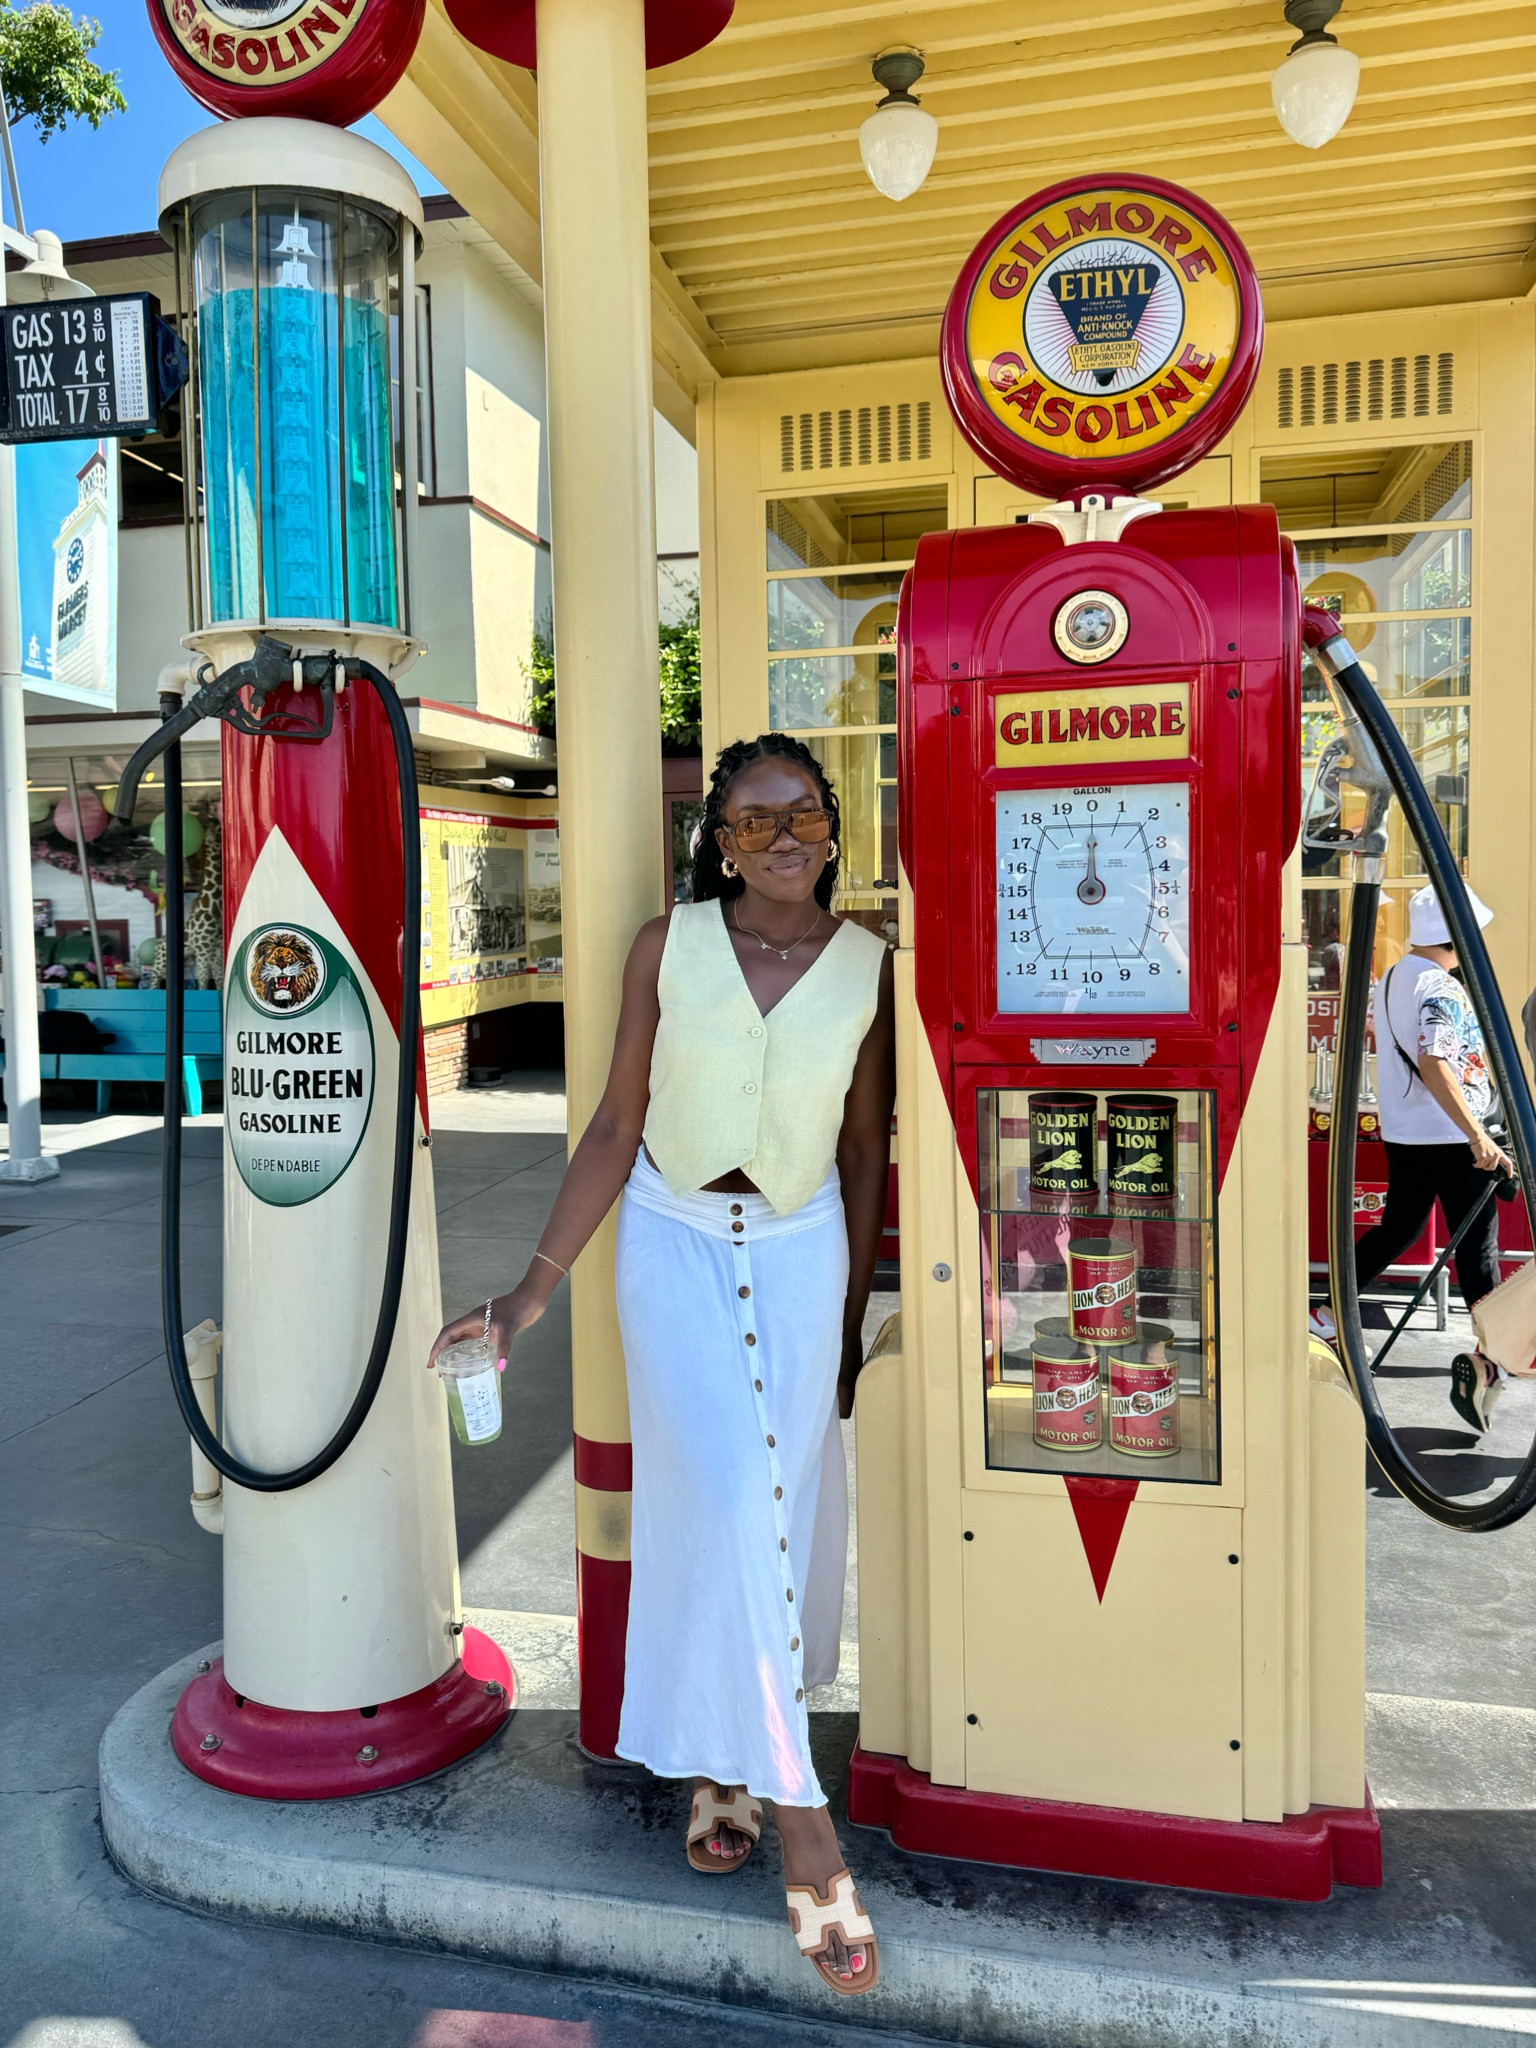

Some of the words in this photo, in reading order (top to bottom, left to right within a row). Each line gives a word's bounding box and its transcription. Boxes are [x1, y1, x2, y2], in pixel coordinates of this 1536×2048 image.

[990, 202, 1217, 300] GILMORE
[1074, 246, 1138, 266] with
[1060, 268, 1152, 302] ETHYL
[1080, 314, 1112, 324] BRAND
[1114, 312, 1128, 320] OF
[12, 312, 54, 350] GAS
[60, 310, 86, 344] 13
[1078, 320, 1133, 334] ANTI-KNOCK
[1084, 331, 1128, 341] COMPOUND
[1074, 345, 1098, 355] ETHYL
[1100, 342, 1137, 352] GASOLINE
[1080, 351, 1131, 362] CORPORATION
[14, 352, 56, 390] TAX
[74, 350, 88, 384] 4
[988, 343, 1216, 443] GASOLINE
[16, 392, 60, 428] TOTAL
[65, 388, 90, 424] 17
[1000, 701, 1186, 746] GILMORE
[1073, 786, 1112, 796] GALLON
[1052, 802, 1073, 815] 19
[1086, 800, 1098, 812] 0
[1117, 801, 1127, 813] 1
[1021, 812, 1042, 826] 18
[1148, 808, 1160, 821] 2
[1011, 837, 1032, 850] 17
[1156, 836, 1167, 849] 3
[1007, 862, 1028, 875] 16
[1158, 859, 1171, 872] 4
[1007, 885, 1029, 898] 15
[1158, 882, 1170, 895] 5
[1007, 908, 1029, 921] 14
[1158, 905, 1170, 918] 6
[1009, 930, 1031, 943] 13
[1158, 931, 1170, 944] 7
[1016, 962, 1038, 975] 12
[1148, 962, 1161, 976] 8
[1050, 968, 1070, 981] 11
[1081, 971, 1103, 984] 10
[1119, 968, 1131, 981] 9
[236, 1030, 343, 1054] GILMORE
[1054, 1044, 1130, 1059] Wayne
[231, 1066, 364, 1100] BLU-GREEN
[240, 1111, 342, 1134] GASOLINE
[1030, 1110, 1089, 1128] GOLDEN
[1108, 1113, 1170, 1131] GOLDEN
[1037, 1130, 1076, 1146] LION
[1116, 1133, 1157, 1149] LION
[251, 1158, 321, 1173] DEPENDABLE
[1031, 1175, 1067, 1189] MOTOR
[1070, 1179, 1090, 1189] OIL
[1109, 1178, 1147, 1193] MOTOR
[1151, 1182, 1170, 1193] OIL
[1074, 1291, 1094, 1308] LION
[1079, 1325, 1117, 1337] MOTOR
[1121, 1325, 1134, 1336] OIL
[1036, 1394, 1054, 1410] LION
[1112, 1400, 1130, 1415] LION
[1040, 1428, 1078, 1442] MOTOR
[1082, 1430, 1096, 1441] OIL
[1116, 1432, 1154, 1447] MOTOR
[1158, 1435, 1174, 1446] OIL
